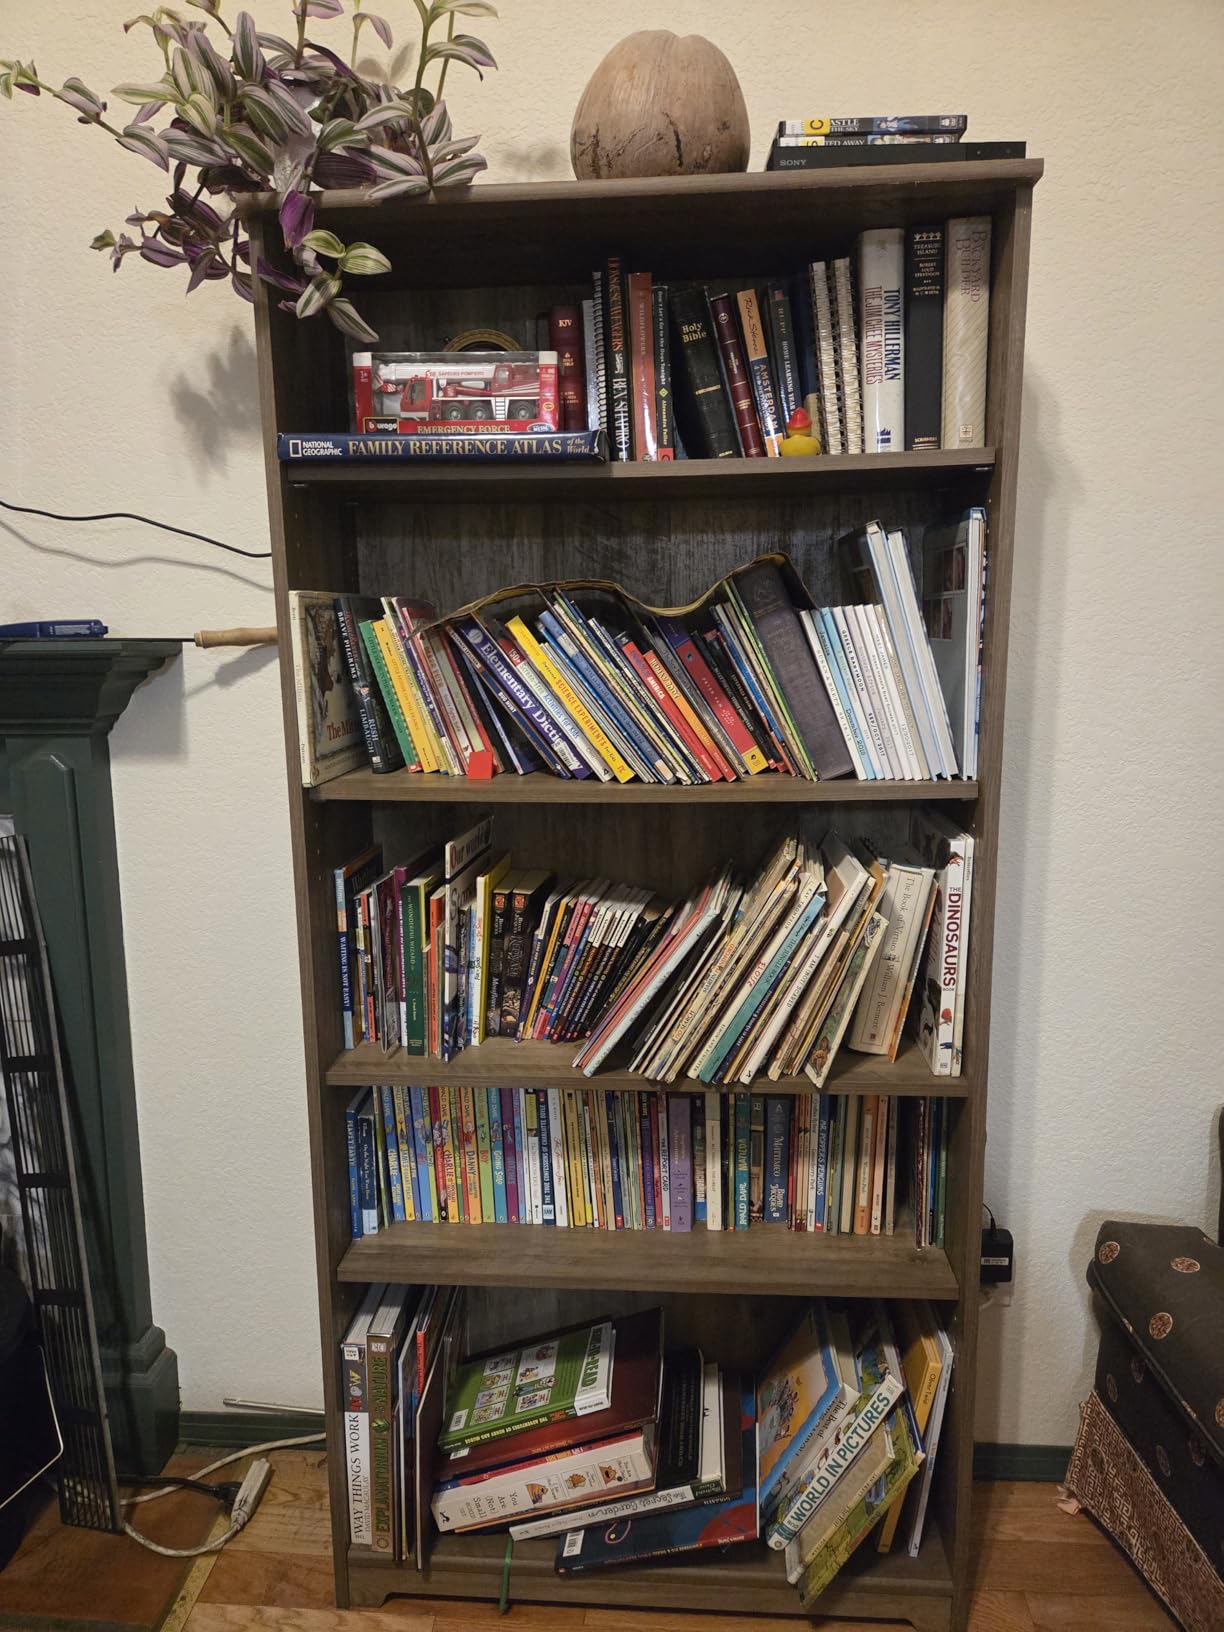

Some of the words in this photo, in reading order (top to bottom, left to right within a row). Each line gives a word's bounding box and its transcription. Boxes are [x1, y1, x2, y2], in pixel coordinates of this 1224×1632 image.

[957, 238, 970, 296] BUILDER
[972, 231, 986, 303] BACKYARD
[865, 286, 882, 301] THE
[883, 288, 901, 318] TONY
[865, 301, 882, 316] JIM
[559, 319, 572, 327] KJV
[682, 322, 702, 333] Holy
[866, 316, 882, 337] CHEE
[683, 331, 707, 343] Bible
[866, 337, 883, 385] MYSTERIES
[884, 320, 901, 380] HILLERMAN
[613, 378, 627, 399] BEN
[784, 360, 794, 394] LEARNING
[759, 364, 778, 429] AMSTERDAM
[788, 392, 796, 409] YEAR
[417, 425, 477, 433] EMERGENCY
[615, 401, 629, 448] SHAPIRO
[303, 441, 334, 449] NATIONAL
[303, 448, 343, 456] GEOGRAPHIC
[348, 441, 405, 455] FAMILY
[409, 440, 507, 455] REFERENCE
[511, 439, 562, 454] ATLAS
[567, 446, 589, 454] World
[336, 611, 347, 636] BRAVE
[343, 638, 358, 678] PILGRIMS
[479, 641, 536, 712] Elementary
[818, 630, 832, 656] Jamaica
[844, 707, 860, 739] December
[497, 690, 507, 701] BUG
[504, 699, 516, 713] HUNT
[507, 647, 523, 664] 150+
[541, 692, 566, 720] Activities
[560, 716, 572, 727] for
[567, 725, 581, 739] Kids
[841, 628, 853, 655] GREECE
[849, 655, 865, 691] BABYMOON
[867, 711, 880, 741] SEP/OCT
[877, 742, 885, 756] 2017
[554, 678, 577, 706] SCIENCE
[573, 703, 607, 747] EXPERIMENTS
[327, 723, 341, 741] The
[358, 708, 375, 753] LIMBAUGH
[367, 718, 379, 741] RUSH
[899, 723, 914, 756] 12/30/2017
[904, 876, 914, 892] The
[899, 892, 910, 912] Book
[783, 900, 804, 930] THOMPSON
[896, 913, 904, 922] of
[785, 937, 796, 949] THE
[889, 923, 902, 952] Virtues
[943, 892, 961, 987] DINOSAURS
[339, 936, 347, 965] WAITING
[408, 940, 416, 964] WIZARD
[772, 947, 790, 969] JUNGLE
[745, 959, 767, 988] ELOISE
[807, 958, 815, 968] AM
[700, 972, 718, 993] MARTIN
[763, 967, 777, 985] BOOK
[797, 967, 811, 986] (NOT)
[879, 962, 894, 992] William
[342, 986, 350, 1007] EASY!
[489, 977, 499, 1010] Mossflower
[785, 984, 801, 1008] SCARED
[871, 1000, 884, 1029] Bennett
[346, 1120, 354, 1142] PLANET
[539, 1119, 548, 1145] CHARLOTTE
[479, 1149, 488, 1164] BOY
[737, 1138, 748, 1170] MATILDA
[772, 1135, 784, 1176] MATTIMEO
[817, 1132, 826, 1162] POPPER'S
[387, 1148, 399, 1176] CHARLIE
[401, 1150, 409, 1168] JAMES
[443, 1149, 454, 1177] CHARLIE
[466, 1150, 476, 1176] DANNY
[493, 1150, 502, 1169] GOING
[541, 1152, 550, 1181] CONFESSIONS
[659, 1149, 668, 1173] REPORT
[494, 1170, 503, 1185] SOLO
[695, 1166, 704, 1202] ZACHARIAH
[816, 1164, 825, 1195] PENGUINS
[738, 1182, 746, 1200] DAHL
[768, 1183, 778, 1211] JACQUES
[776, 1188, 784, 1207] BRIAN
[738, 1202, 746, 1224] ROALD
[348, 1368, 362, 1409] NOW
[371, 1357, 386, 1403] NATURE
[925, 1373, 936, 1391] Oliver
[831, 1399, 847, 1416] The
[348, 1414, 360, 1453] WORK
[490, 1428, 505, 1437] HENRY
[511, 1418, 539, 1431] ADVENTURES
[815, 1428, 827, 1439] of
[820, 1413, 837, 1432] Best
[464, 1435, 480, 1444] MUDGE
[480, 1432, 490, 1440] AND
[790, 1473, 831, 1524] WORLD
[824, 1457, 844, 1478] IN
[836, 1392, 891, 1461] PICTURES
[350, 1457, 362, 1503] THINGS
[373, 1437, 390, 1532] EXPLANATORIUM
[362, 1475, 370, 1510] MACAULAY
[498, 1495, 507, 1509] Are
[509, 1492, 518, 1506] You
[639, 1492, 674, 1508] Secret
[473, 1496, 488, 1518] Small
[486, 1496, 499, 1514] (Not)
[588, 1500, 638, 1519] Garden
[352, 1505, 364, 1533] WAY
